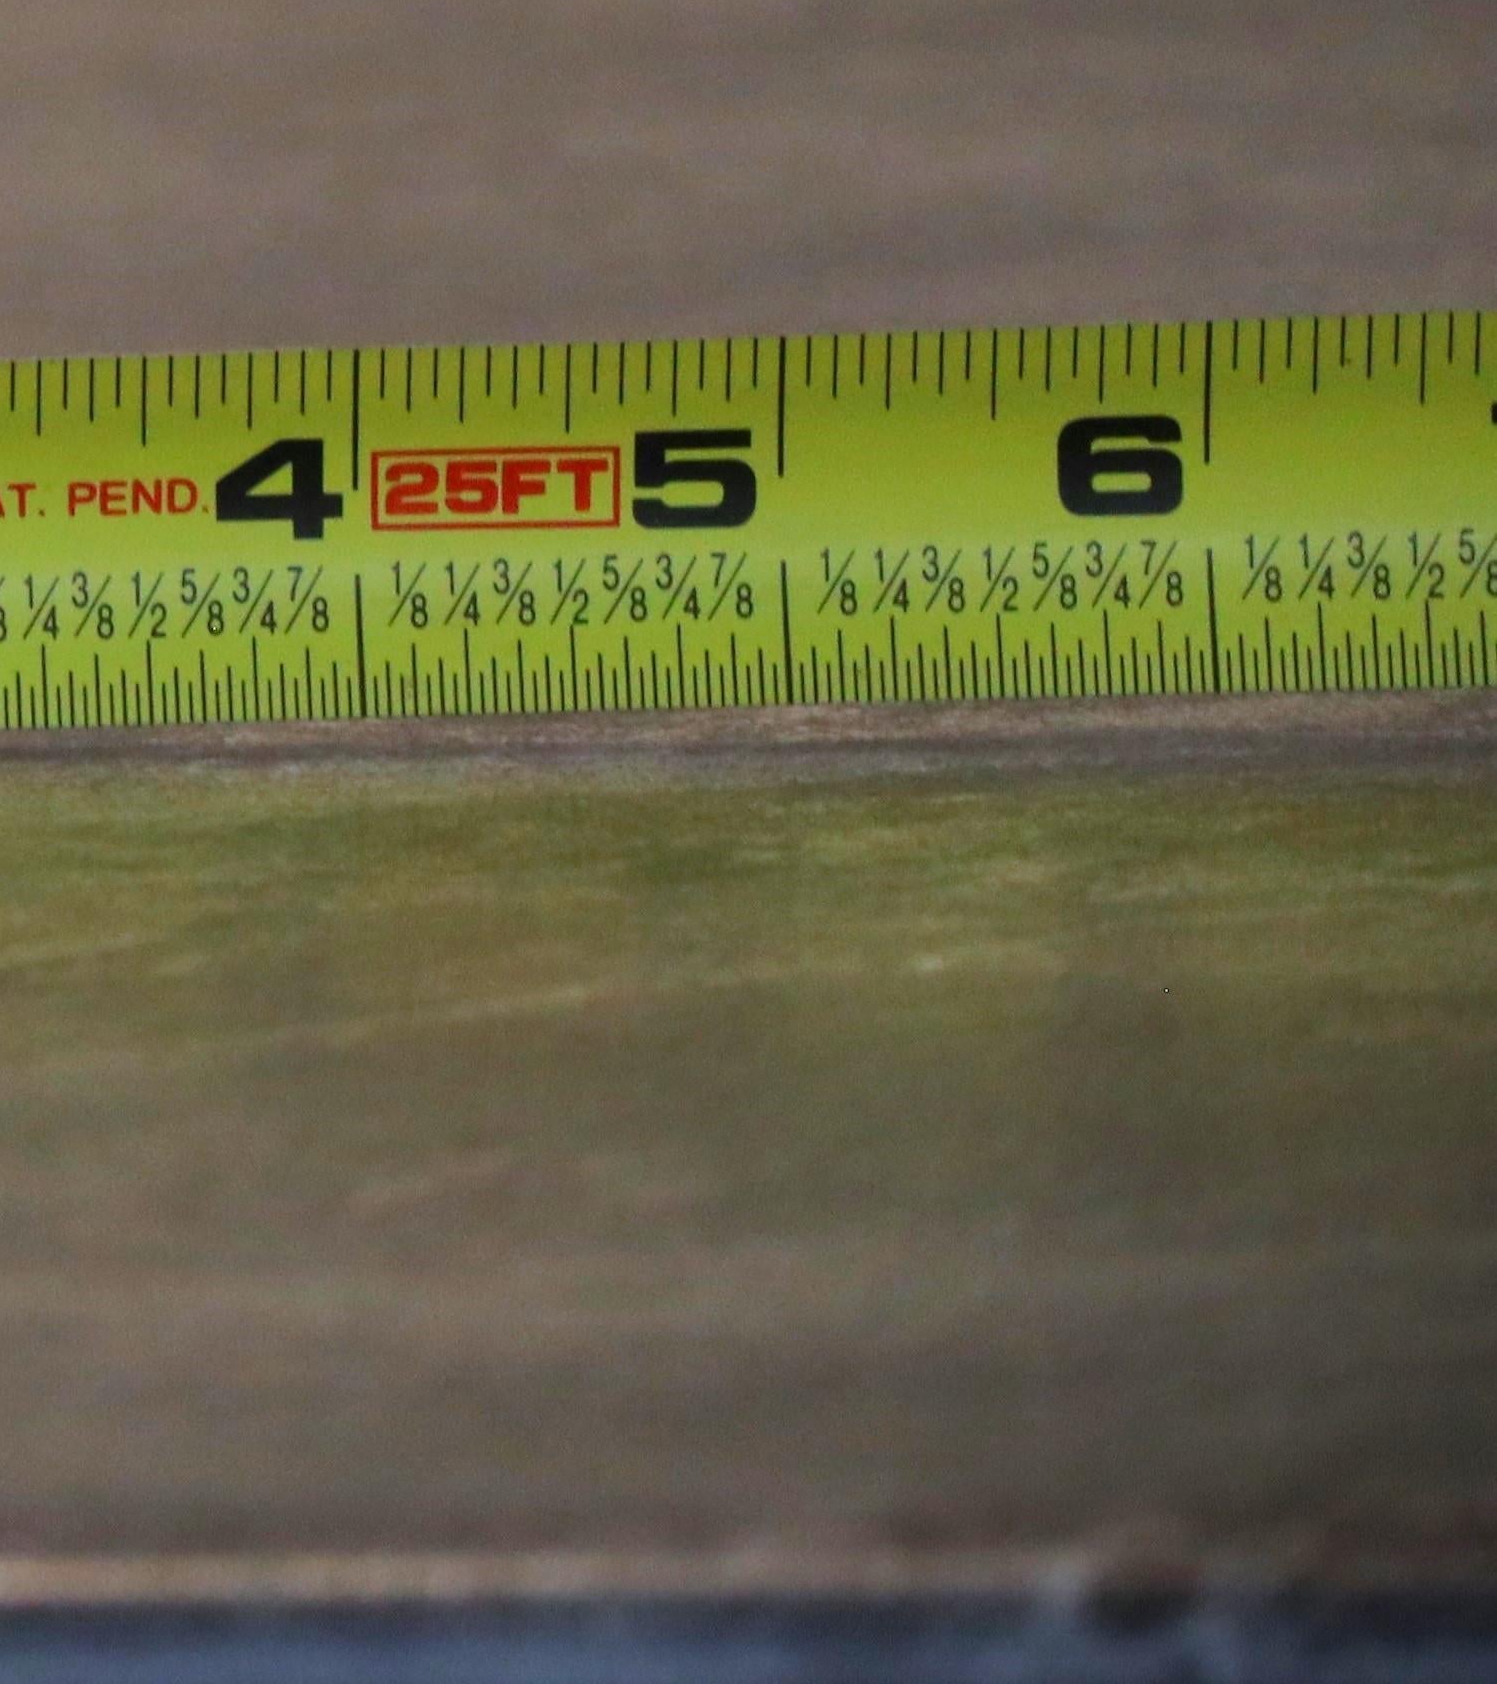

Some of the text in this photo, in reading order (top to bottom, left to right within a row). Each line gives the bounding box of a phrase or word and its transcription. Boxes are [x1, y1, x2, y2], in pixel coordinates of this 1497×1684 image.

[215, 438, 343, 540] 4
[384, 459, 609, 516] 25FT
[632, 428, 757, 529] 5
[1057, 415, 1183, 517] 6
